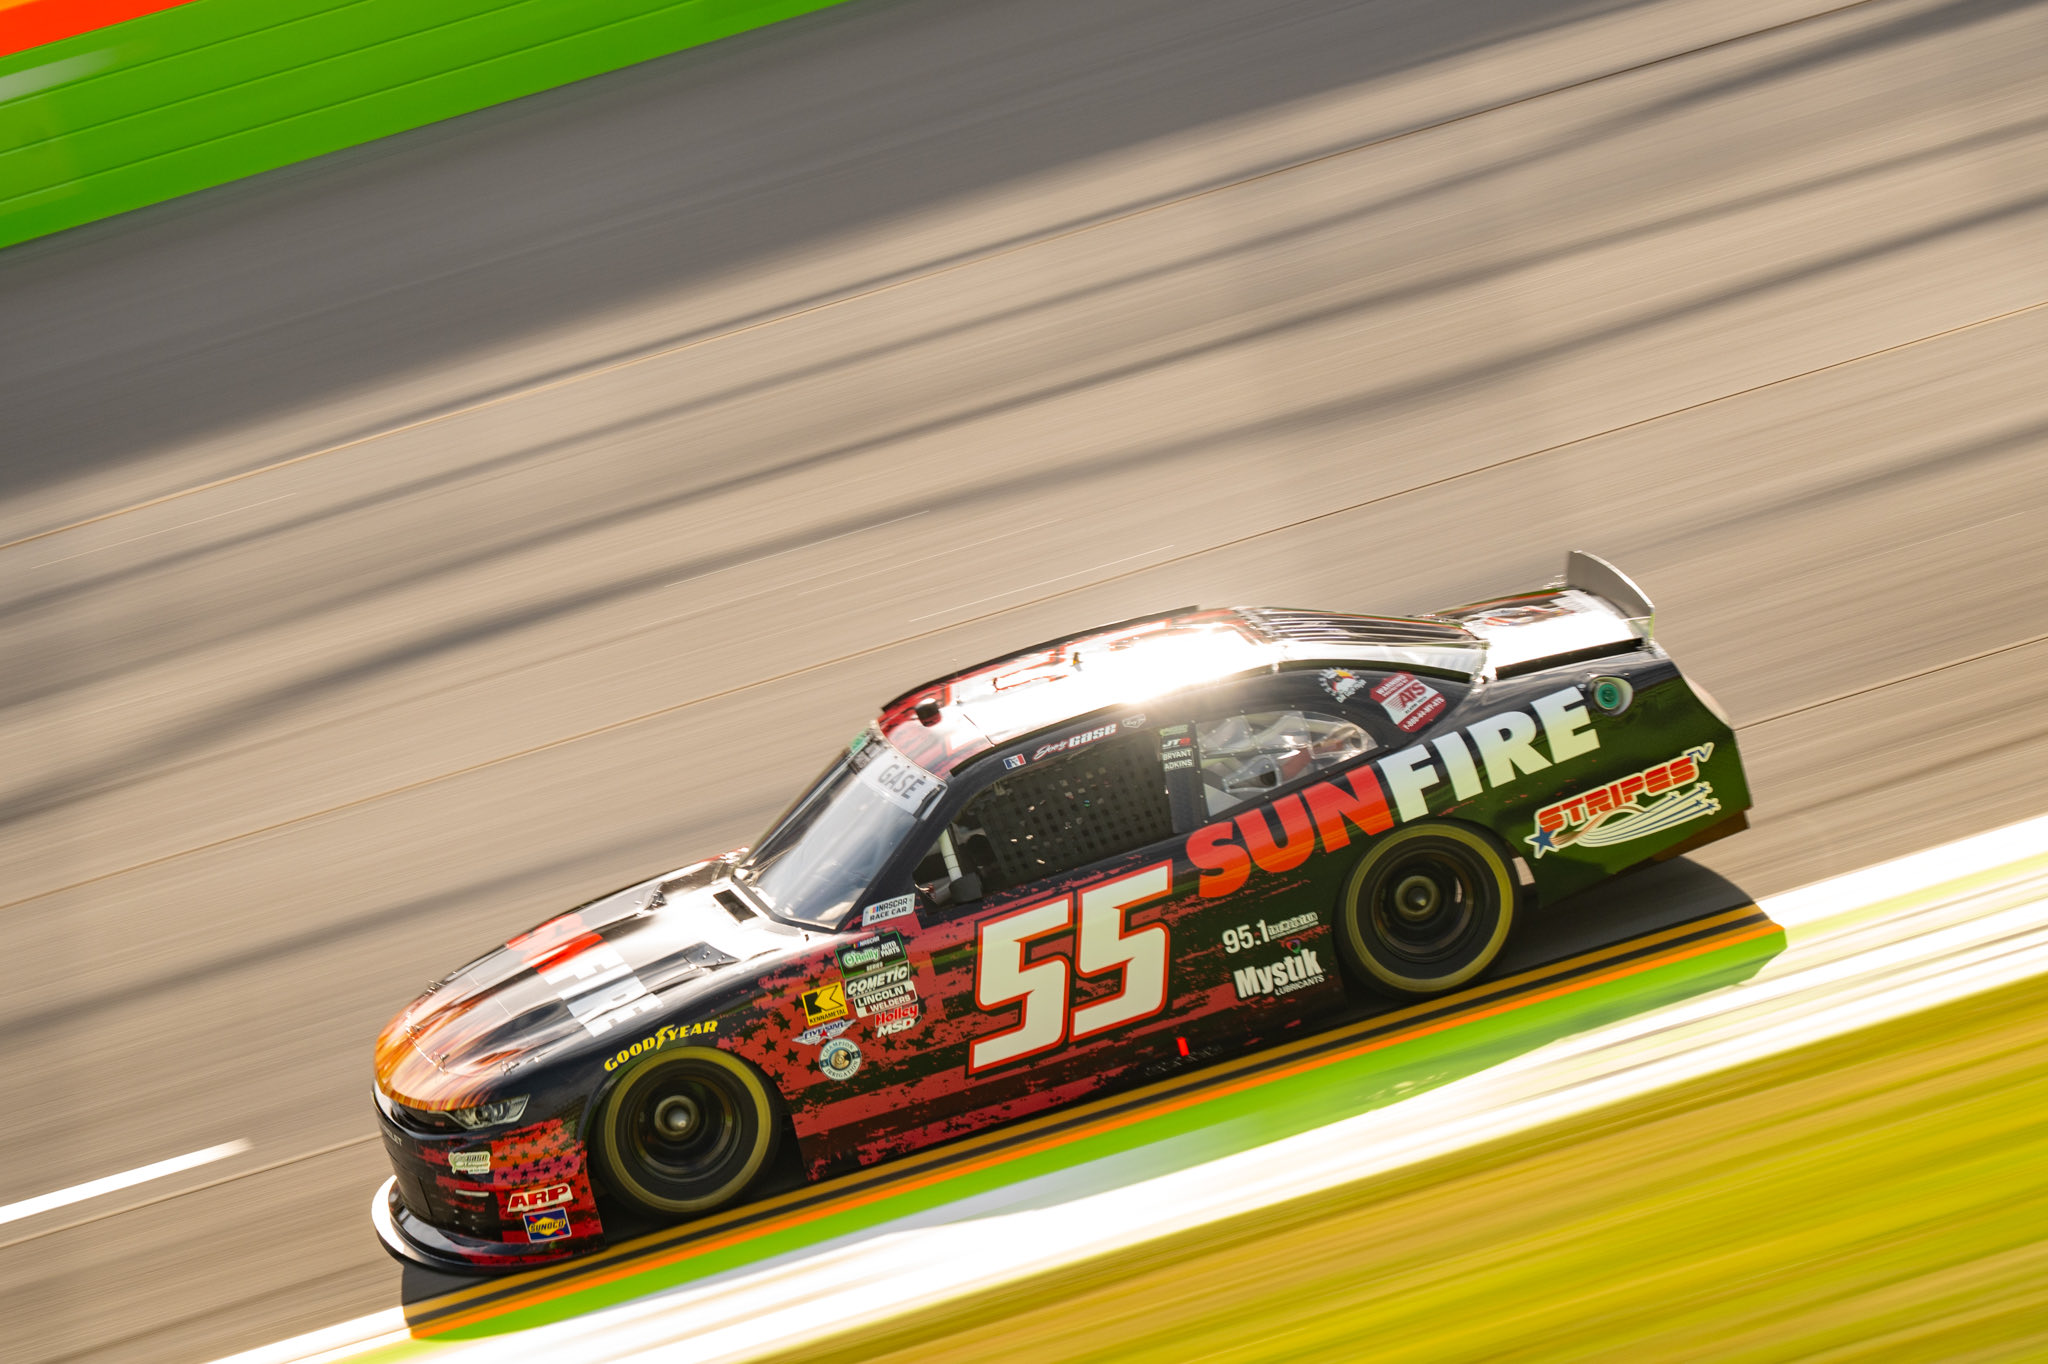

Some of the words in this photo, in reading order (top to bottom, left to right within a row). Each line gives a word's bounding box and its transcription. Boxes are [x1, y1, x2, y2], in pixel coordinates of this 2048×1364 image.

[1398, 681, 1427, 708] ATS
[1162, 749, 1193, 761] BRYANT
[1164, 758, 1194, 771] ADKINS
[877, 763, 926, 799] GASE
[1538, 756, 1697, 834] STRIPES
[1687, 744, 1713, 764] TV
[869, 910, 890, 922] RACE
[891, 906, 908, 916] CAR
[877, 897, 909, 912] NASCAR
[881, 940, 897, 951] AUTO
[1221, 919, 1271, 955] 95.1
[843, 947, 880, 968] O'Reilly
[880, 946, 901, 958] PARTS
[968, 858, 1173, 1075] 55
[1233, 948, 1323, 999] Mystik
[857, 985, 905, 1007] LINCOLN
[1273, 974, 1326, 997] LUBRICANTS
[869, 994, 912, 1013] WELDERS
[809, 1008, 847, 1025] KENNAMETAL
[875, 1003, 918, 1027] Holley
[804, 1028, 822, 1040] FIVE
[876, 1017, 916, 1039] MSD
[603, 1020, 719, 1072] GOODYEAR
[822, 1041, 855, 1058] CHAMPION
[825, 1060, 859, 1078] IRRIGATION
[510, 1185, 569, 1209] ARP
[529, 1217, 566, 1234] SUNOCO
